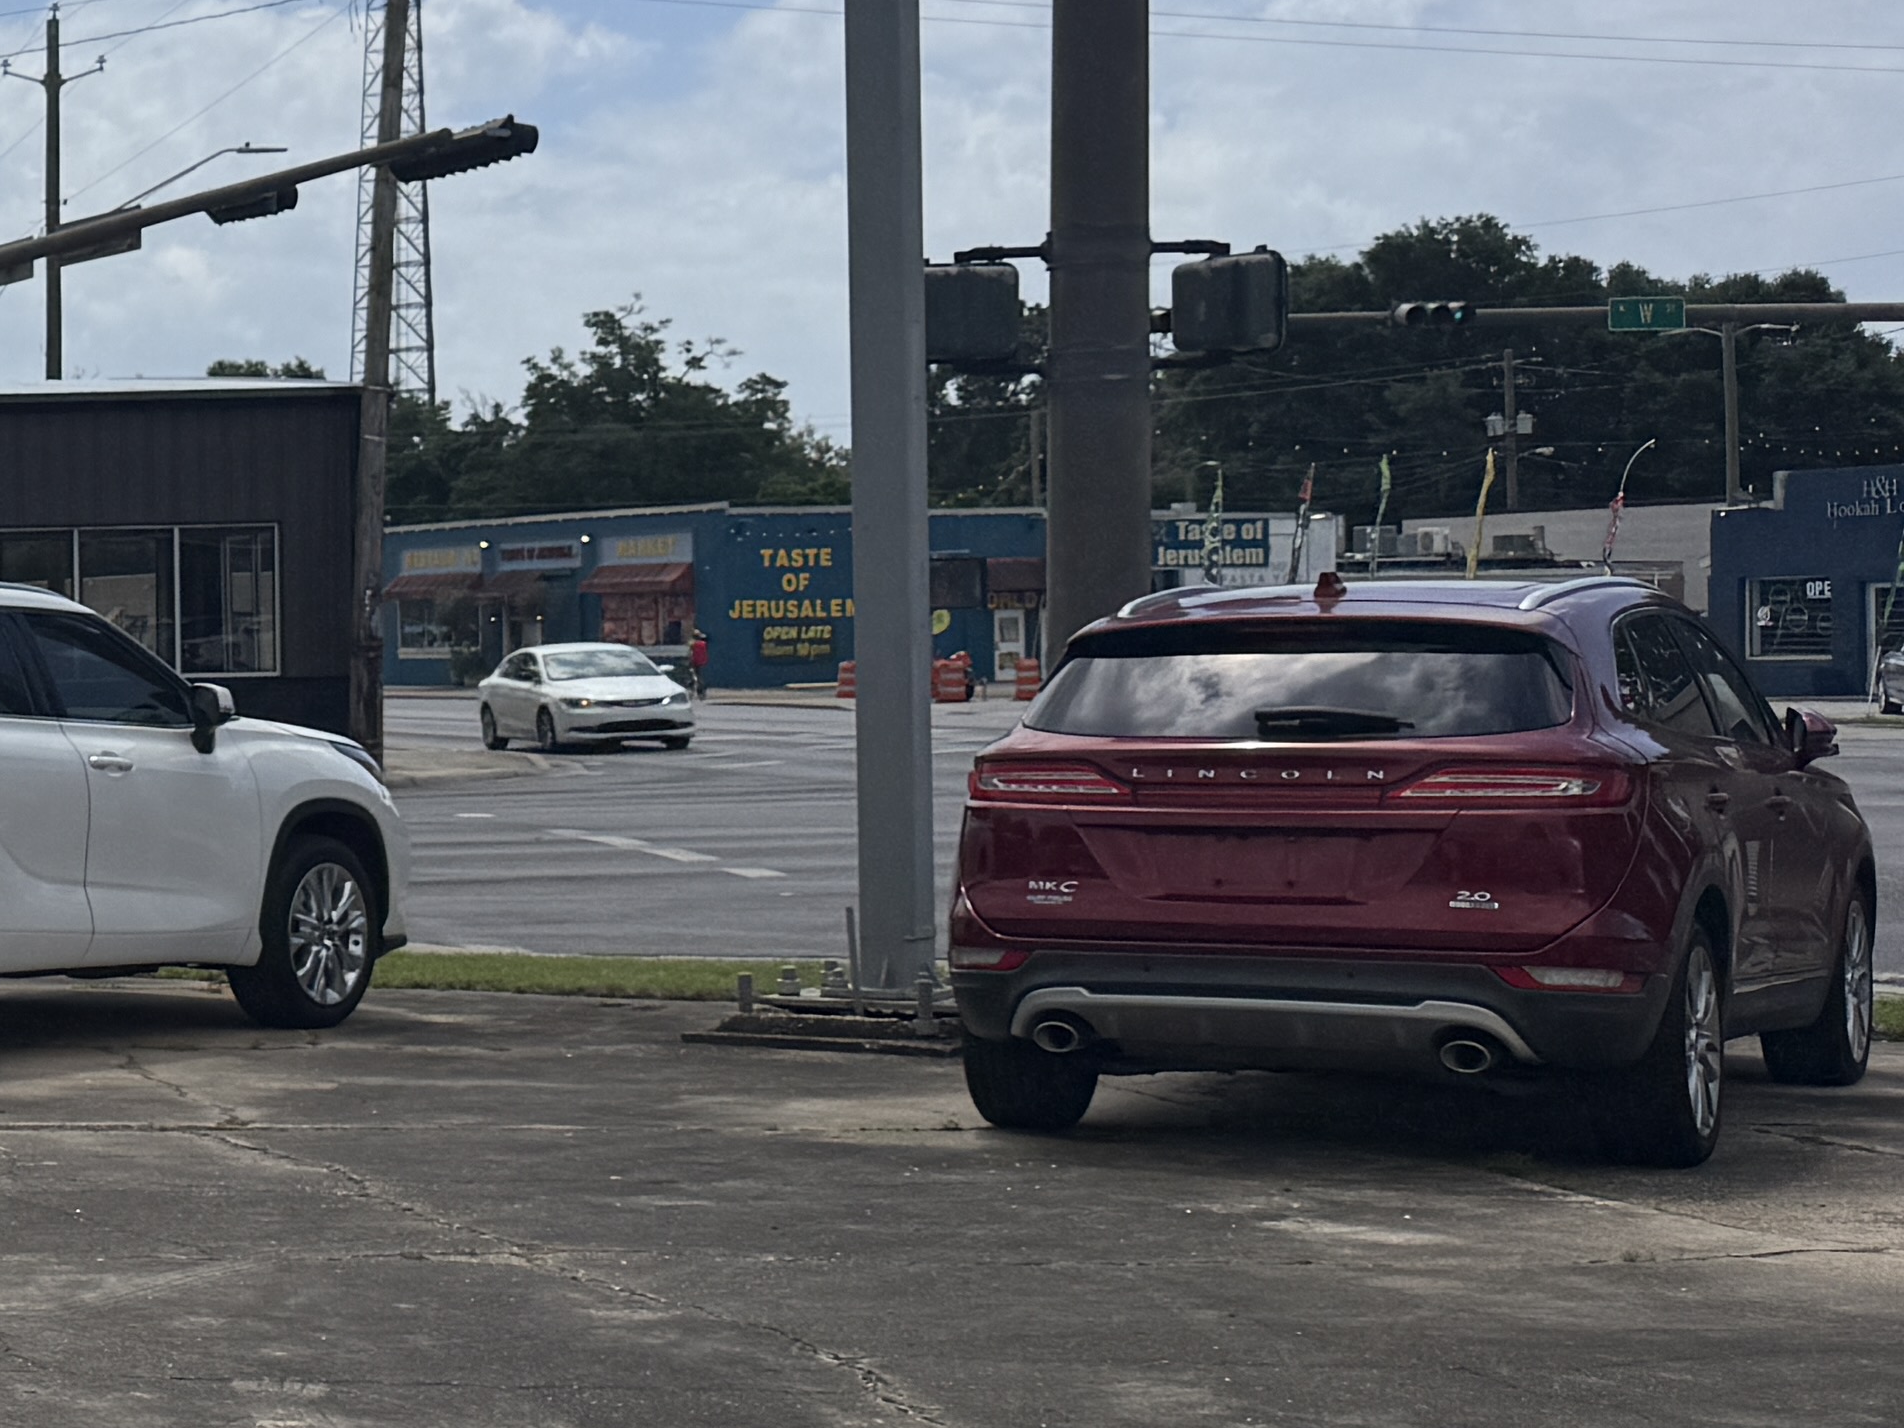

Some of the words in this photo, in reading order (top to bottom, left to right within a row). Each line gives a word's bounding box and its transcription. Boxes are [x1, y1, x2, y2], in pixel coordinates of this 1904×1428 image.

[1639, 303, 1653, 324] W
[1862, 475, 1898, 498] H&H
[1826, 500, 1880, 518] Hookah
[1175, 520, 1237, 541] Tae
[1240, 519, 1264, 541] of
[759, 547, 833, 568] TASTE
[1156, 544, 1265, 566] Jerulem
[781, 573, 810, 592] OF
[763, 625, 798, 640] OPEN
[801, 624, 832, 639] LATE
[1132, 767, 1385, 781] LINCOLN
[1028, 880, 1079, 893] MKC
[1456, 890, 1491, 902] 2.0
